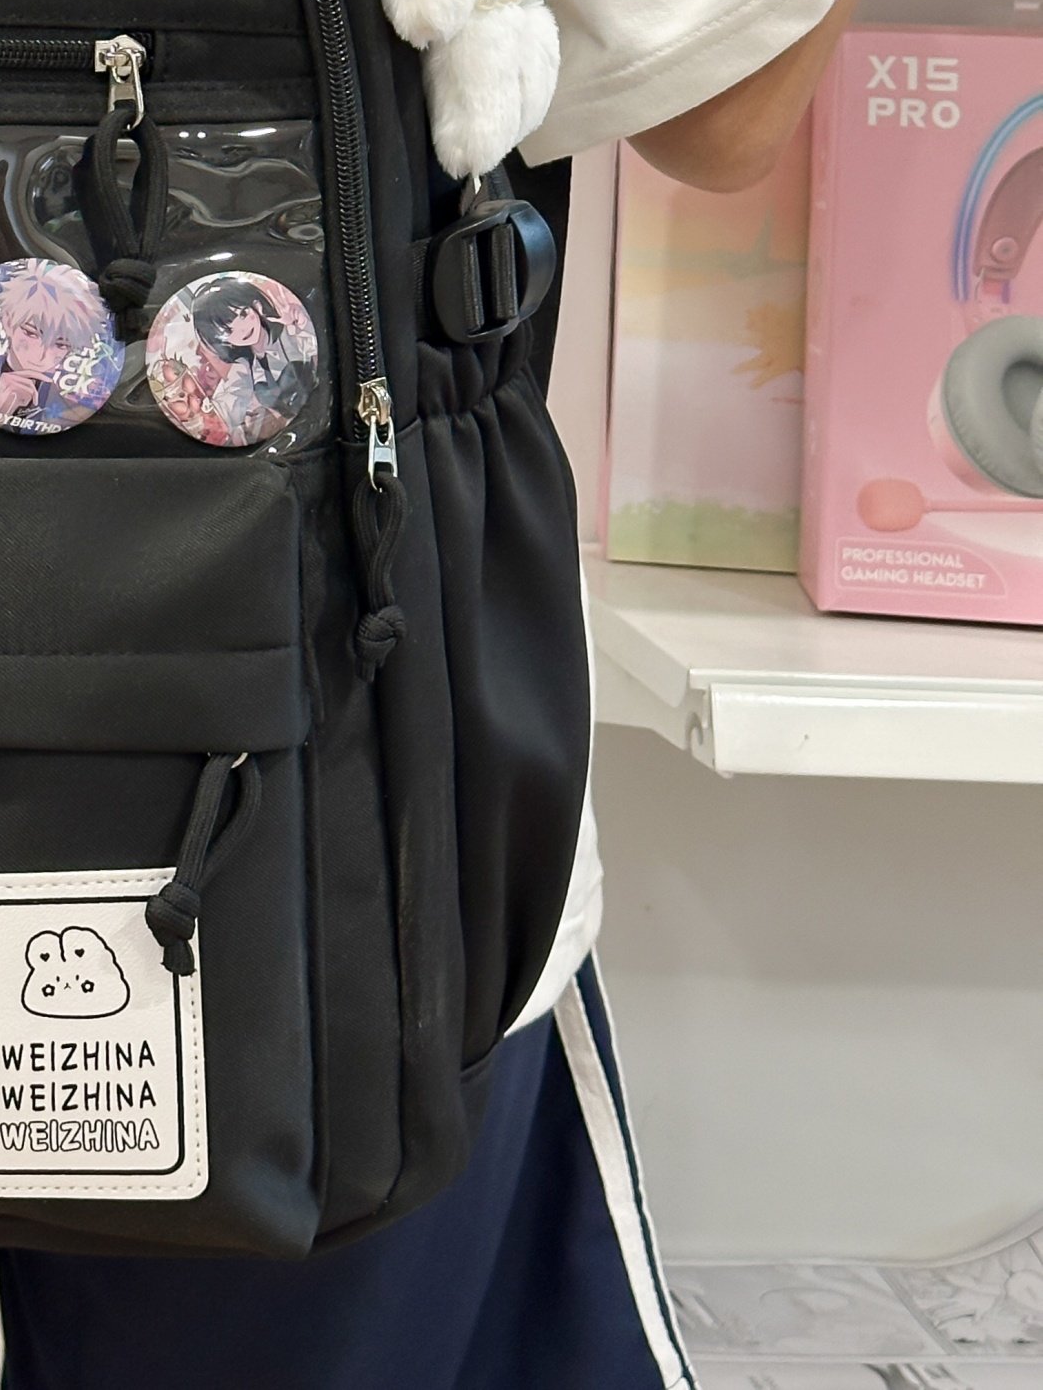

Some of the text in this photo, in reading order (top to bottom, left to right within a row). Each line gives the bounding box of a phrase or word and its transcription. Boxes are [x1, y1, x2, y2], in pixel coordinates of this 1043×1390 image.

[866, 55, 959, 92] X15
[867, 97, 961, 129] PRO
[842, 547, 964, 569] PROFESSIONAL
[841, 565, 987, 589] GAMING HEADSET
[1, 1039, 156, 1072] WEIZHINA
[1, 1079, 157, 1113] WEIZHINA
[0, 1117, 160, 1154] WEIZHINA
